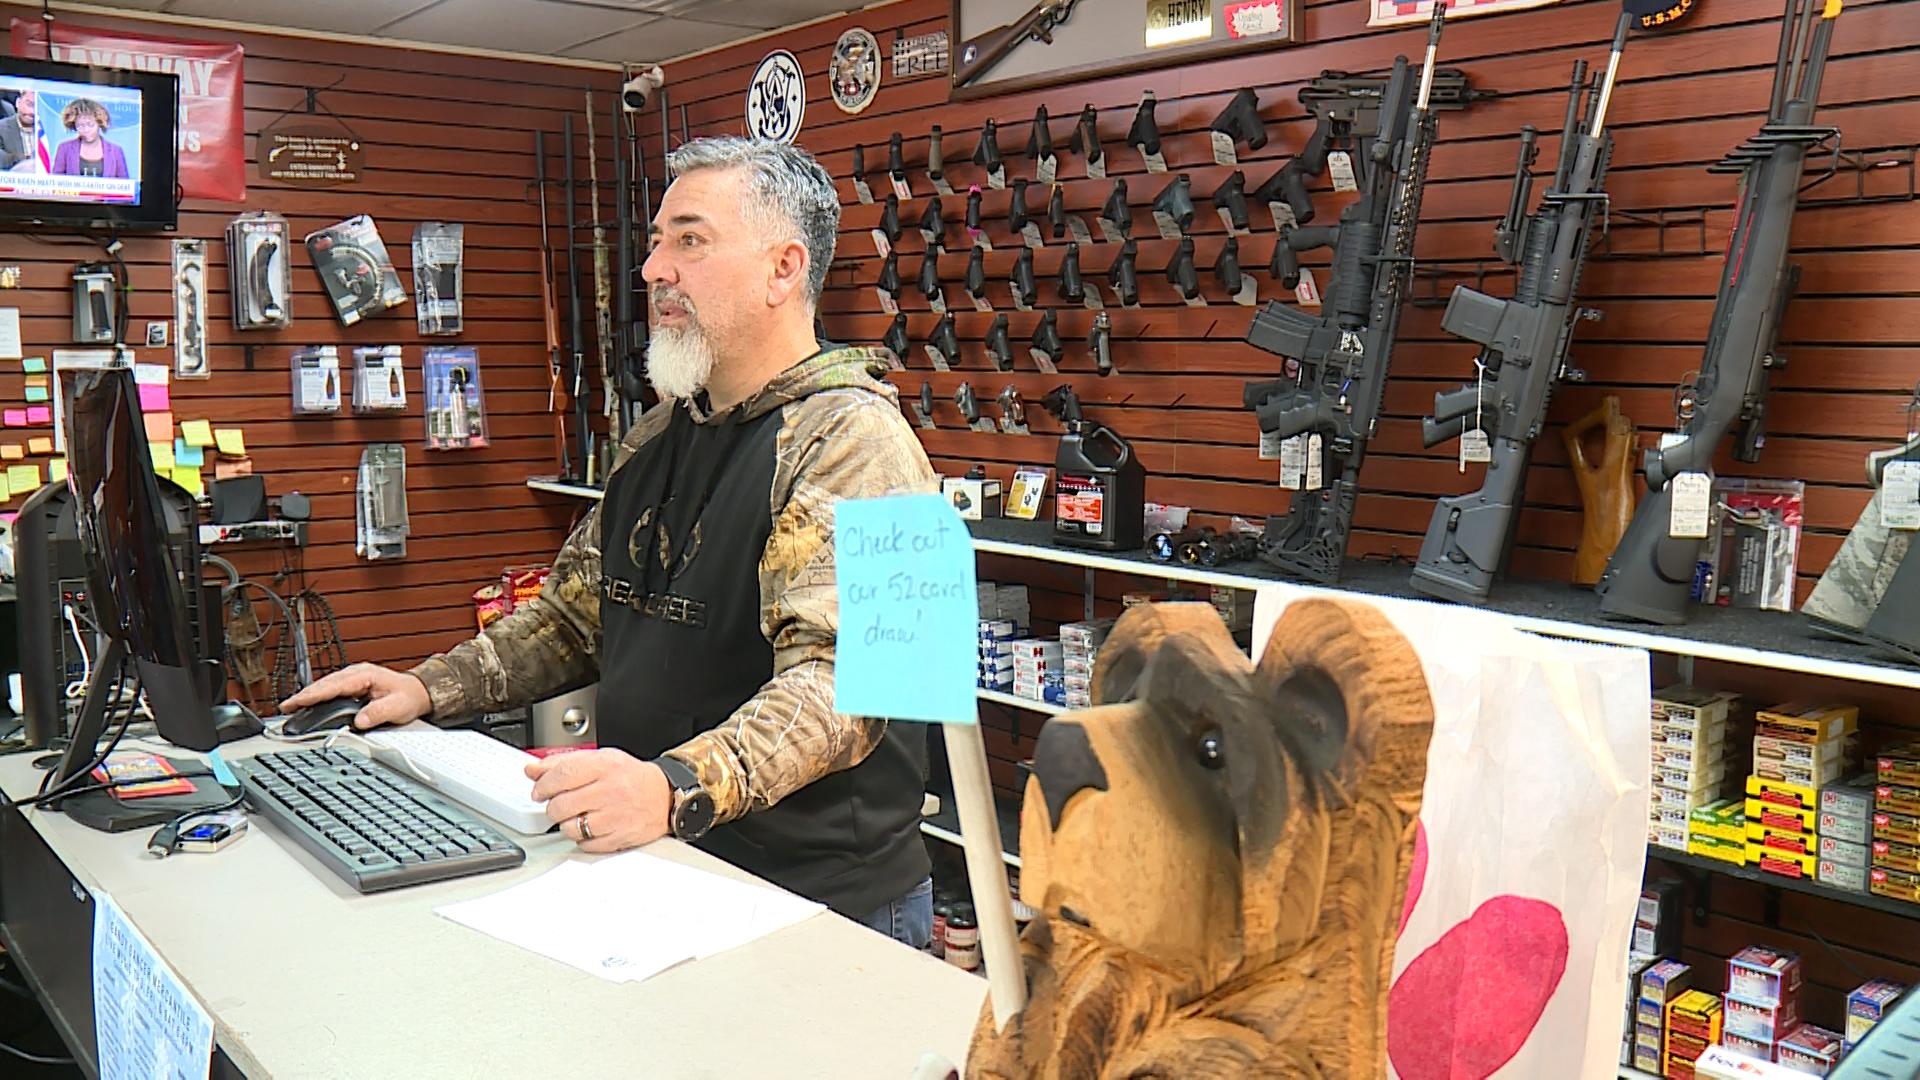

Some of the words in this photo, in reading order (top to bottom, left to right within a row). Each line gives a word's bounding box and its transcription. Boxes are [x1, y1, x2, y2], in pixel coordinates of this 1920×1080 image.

[1168, 0, 1205, 27] HENRY
[842, 521, 904, 557] Check
[911, 517, 950, 553] out
[847, 582, 879, 605] our
